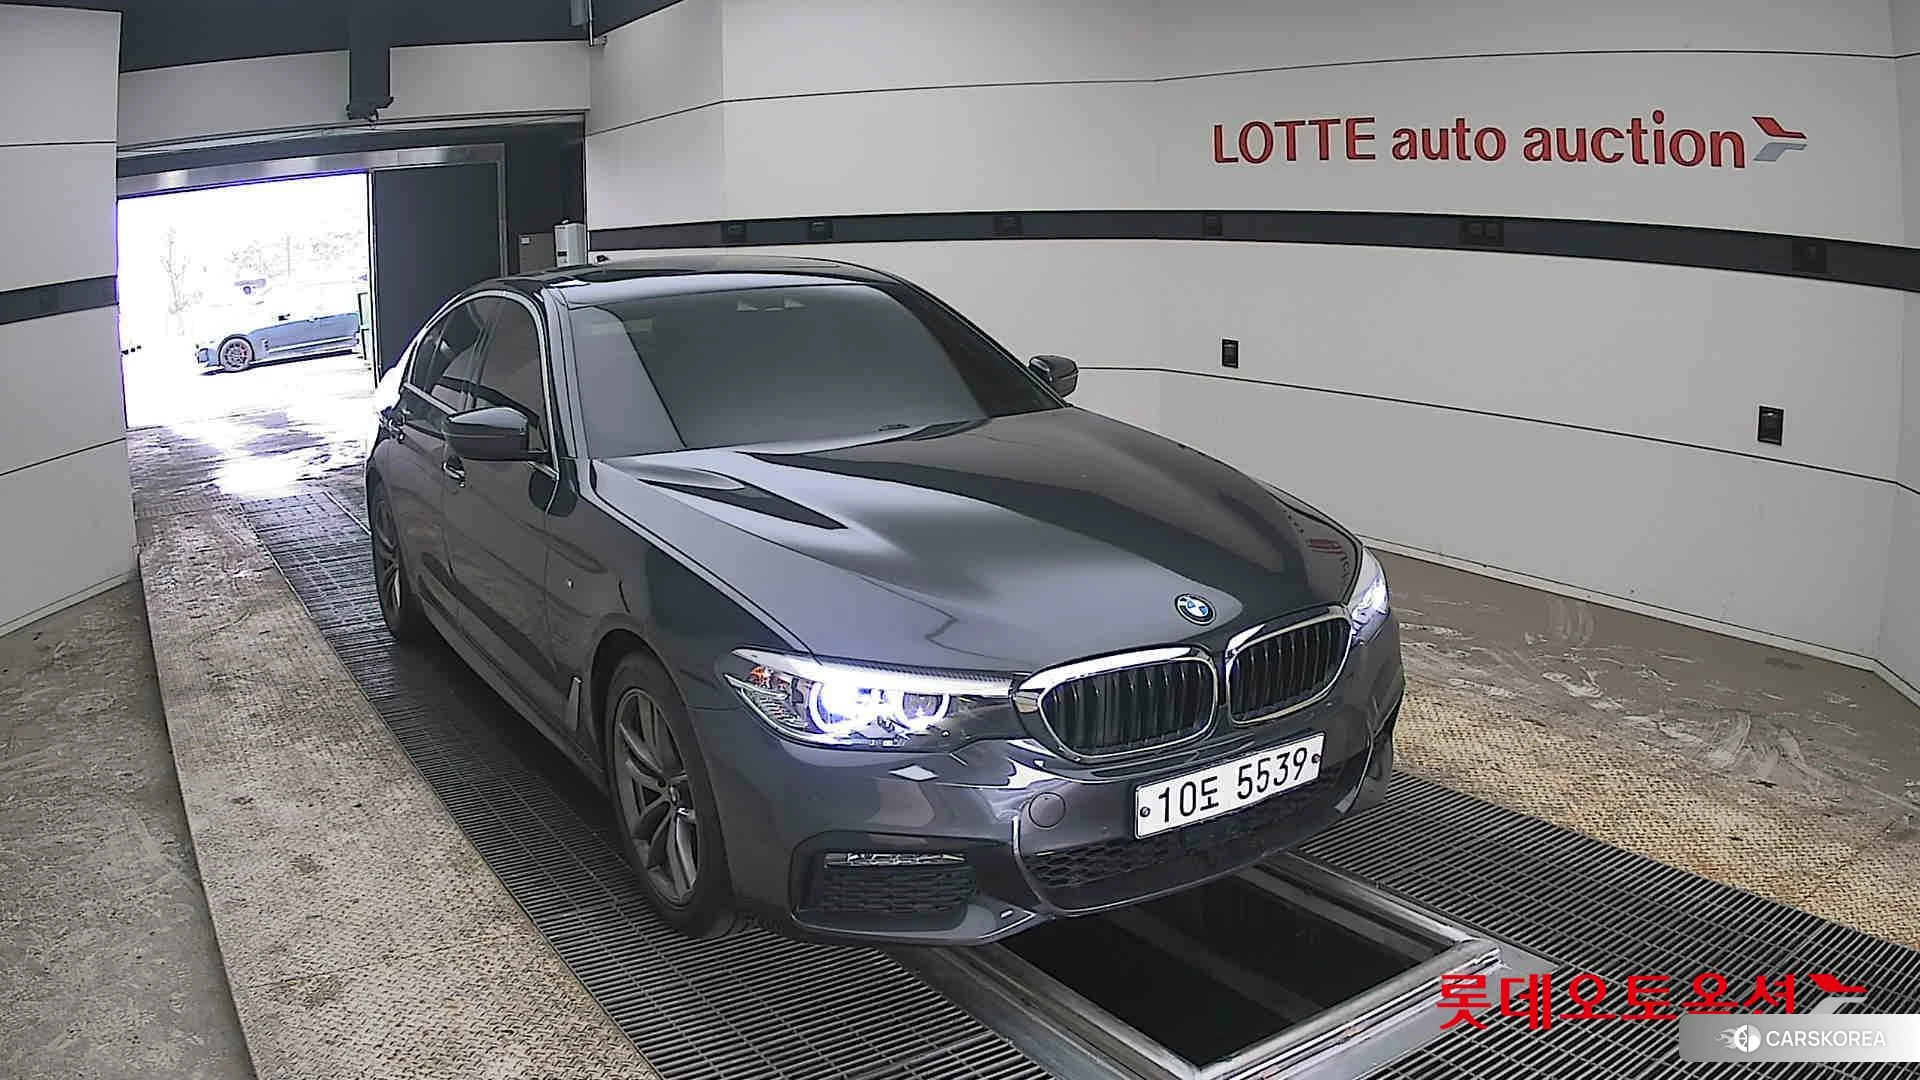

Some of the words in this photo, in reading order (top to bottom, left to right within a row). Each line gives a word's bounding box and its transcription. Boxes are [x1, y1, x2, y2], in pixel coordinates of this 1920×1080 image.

[1213, 117, 1376, 164] LOTTE
[1392, 117, 1508, 162] auto
[1523, 111, 1746, 169] auction
[1158, 776, 1219, 823] 10도
[1237, 747, 1308, 800] 5539
